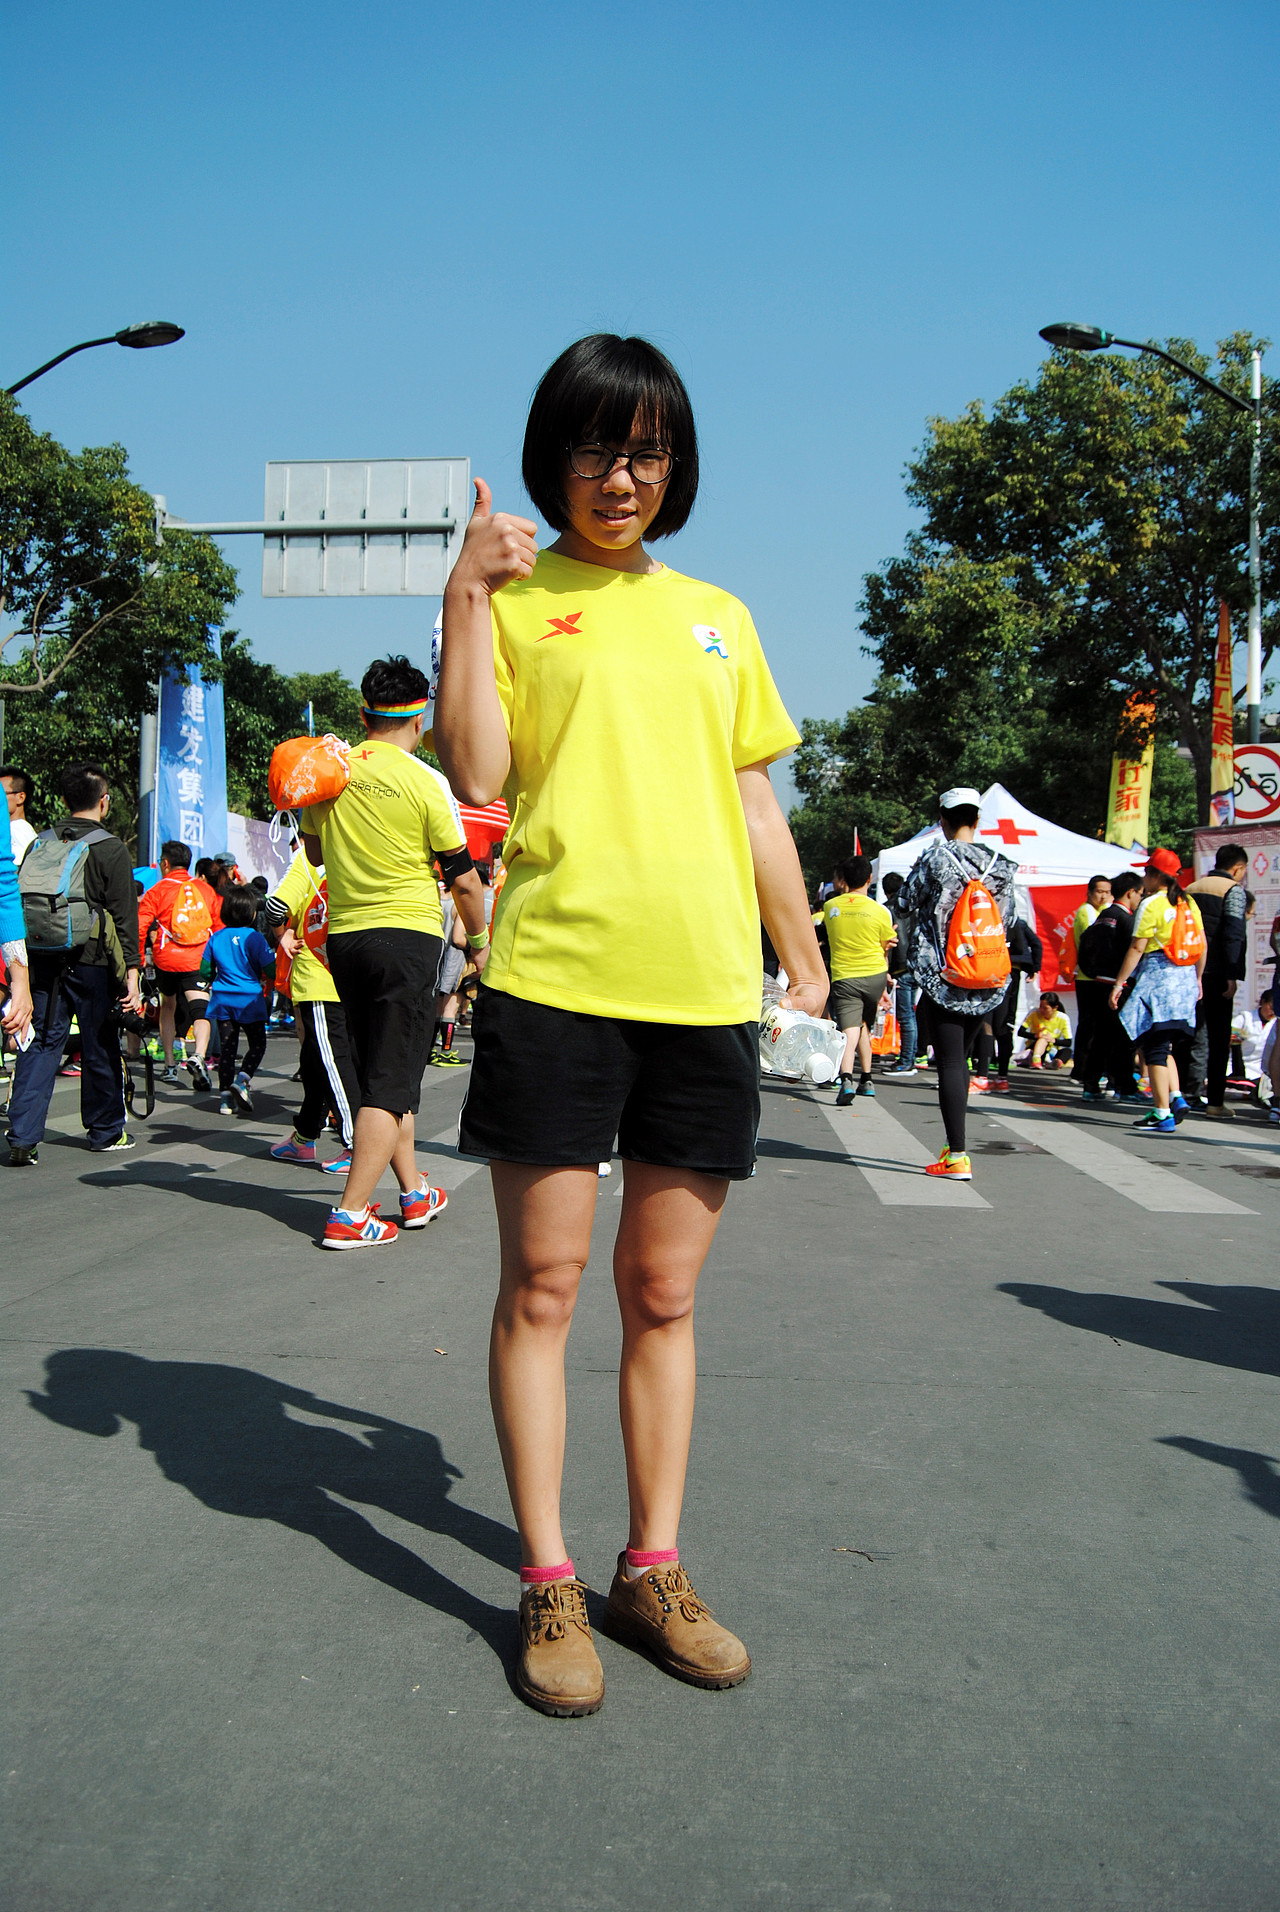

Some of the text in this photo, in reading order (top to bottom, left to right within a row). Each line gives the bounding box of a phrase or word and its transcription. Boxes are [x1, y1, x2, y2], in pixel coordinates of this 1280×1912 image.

[177, 683, 205, 848] 建发集团
[348, 780, 401, 799] ARATHON
[365, 1222, 381, 1240] N
